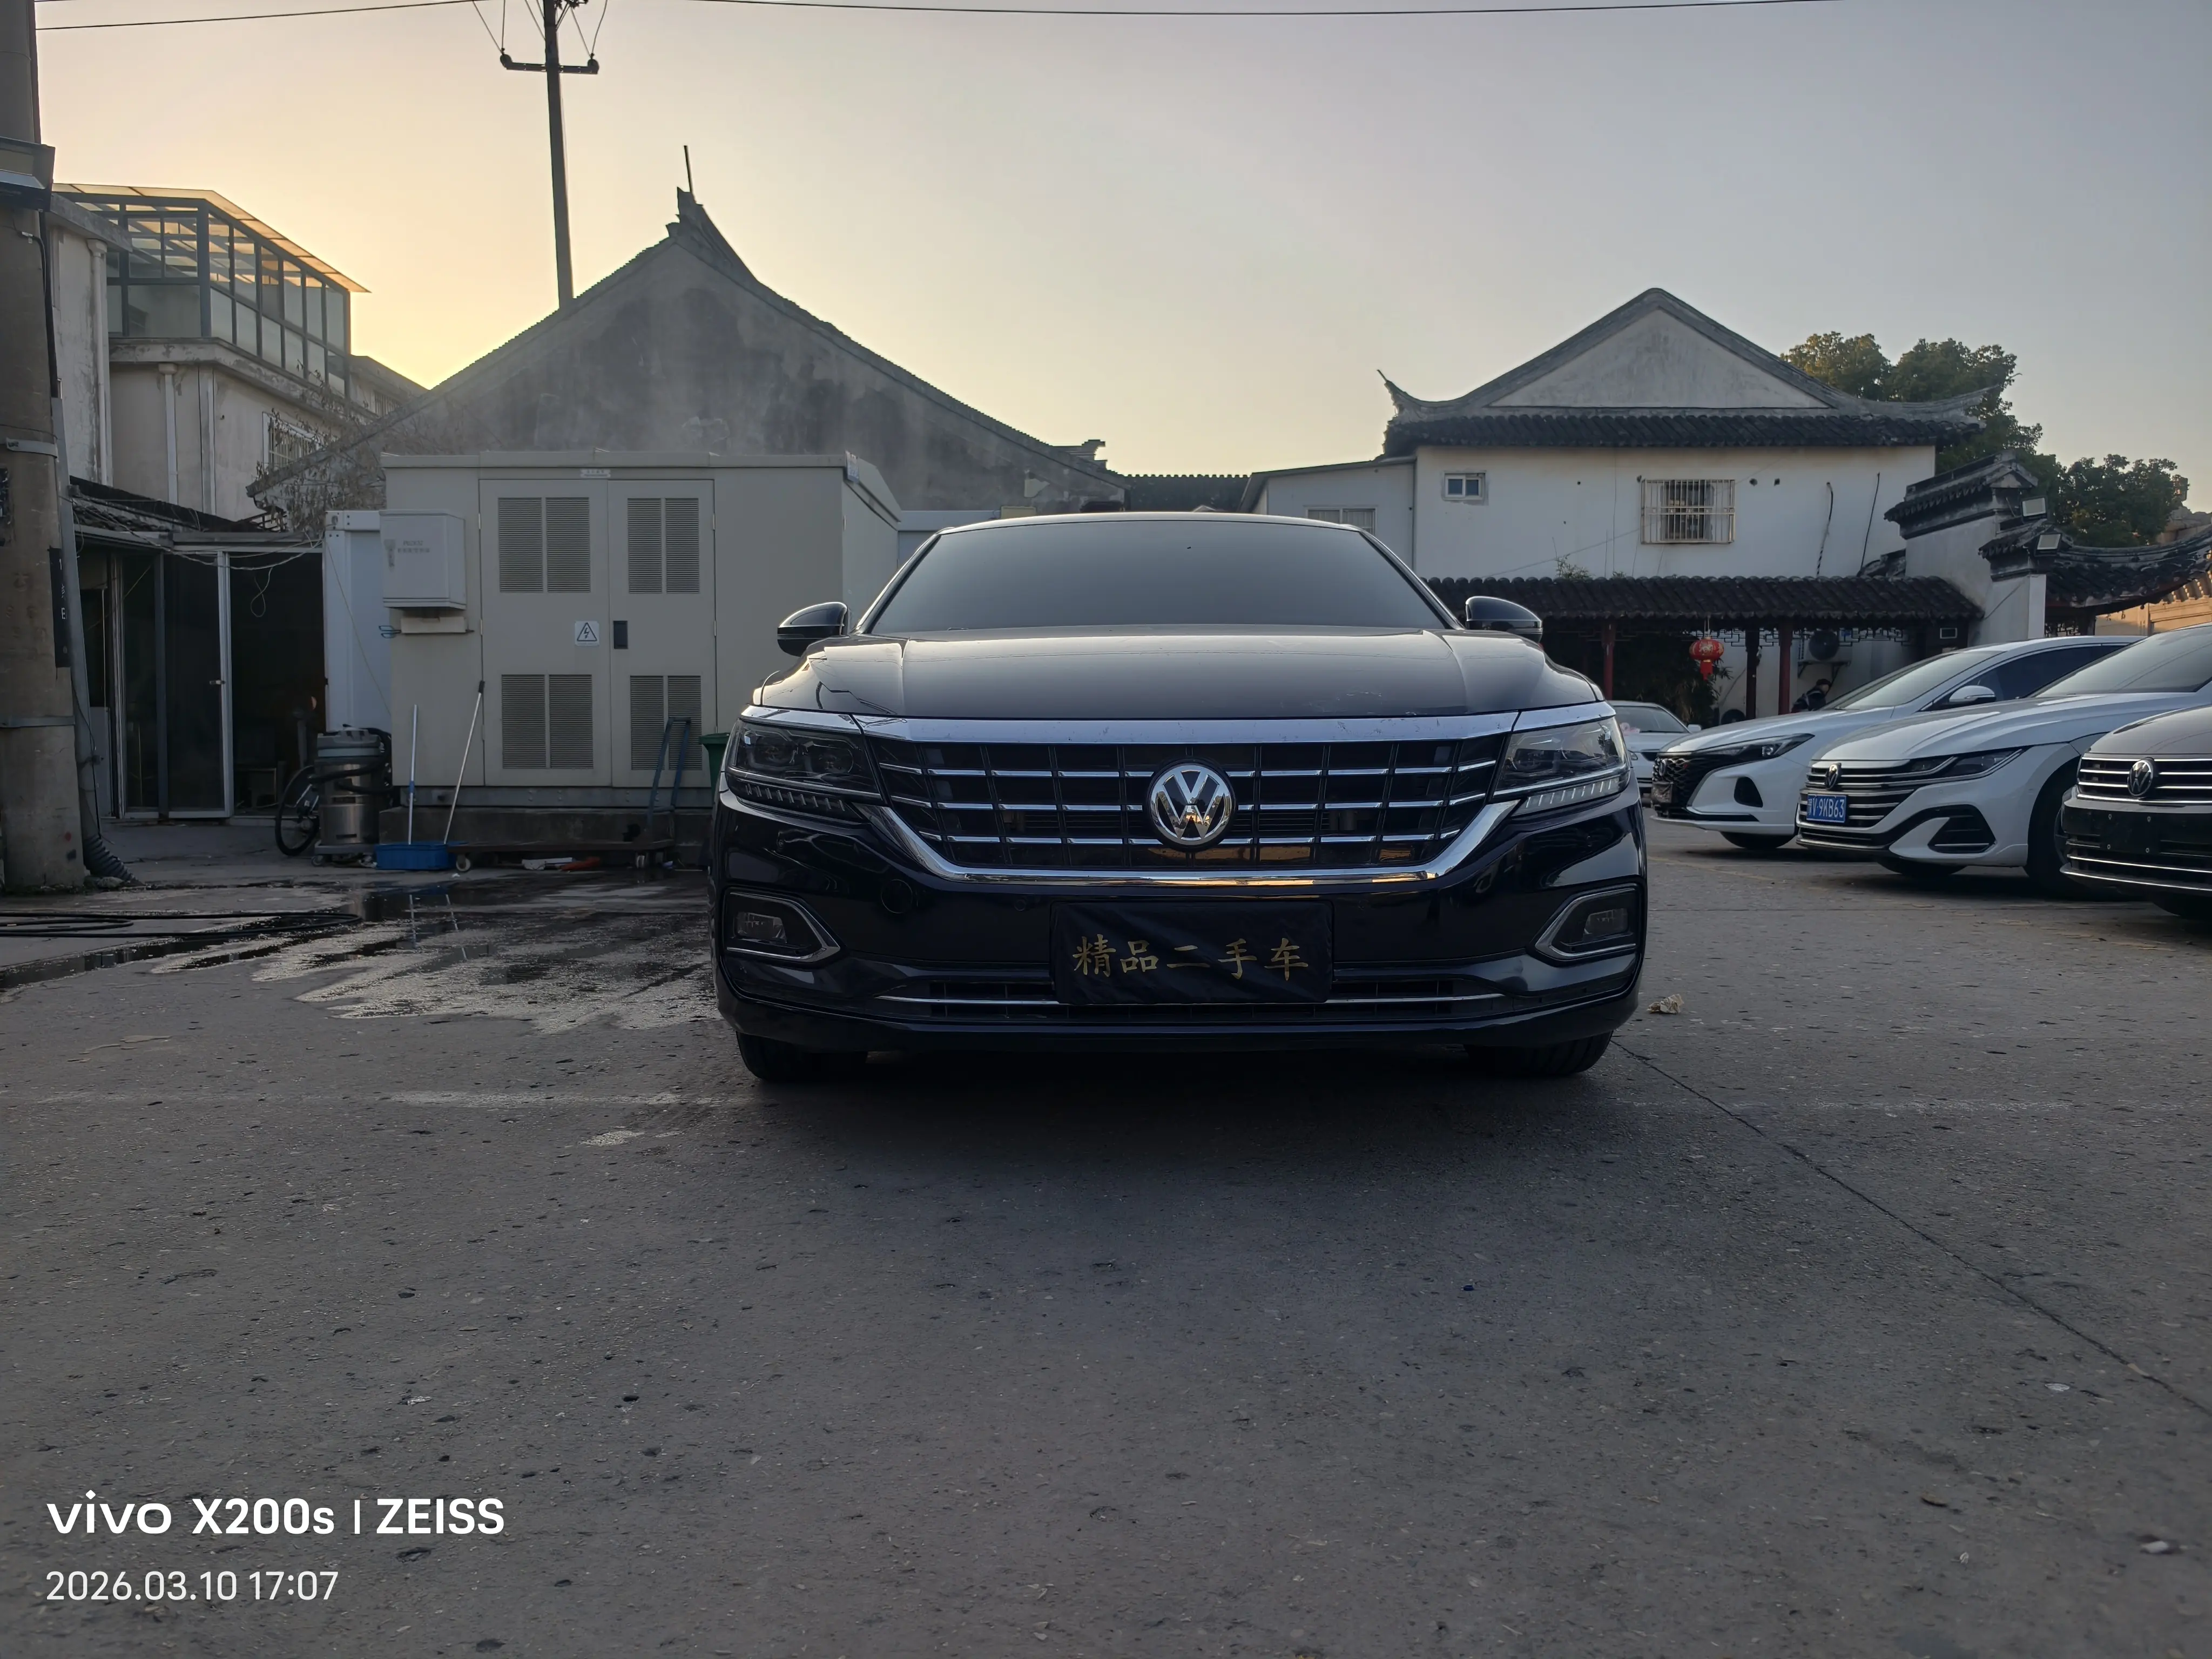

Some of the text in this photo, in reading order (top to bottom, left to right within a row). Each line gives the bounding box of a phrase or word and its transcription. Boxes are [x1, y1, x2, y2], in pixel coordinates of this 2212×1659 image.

[1072, 934, 1309, 981] 精品二手车
